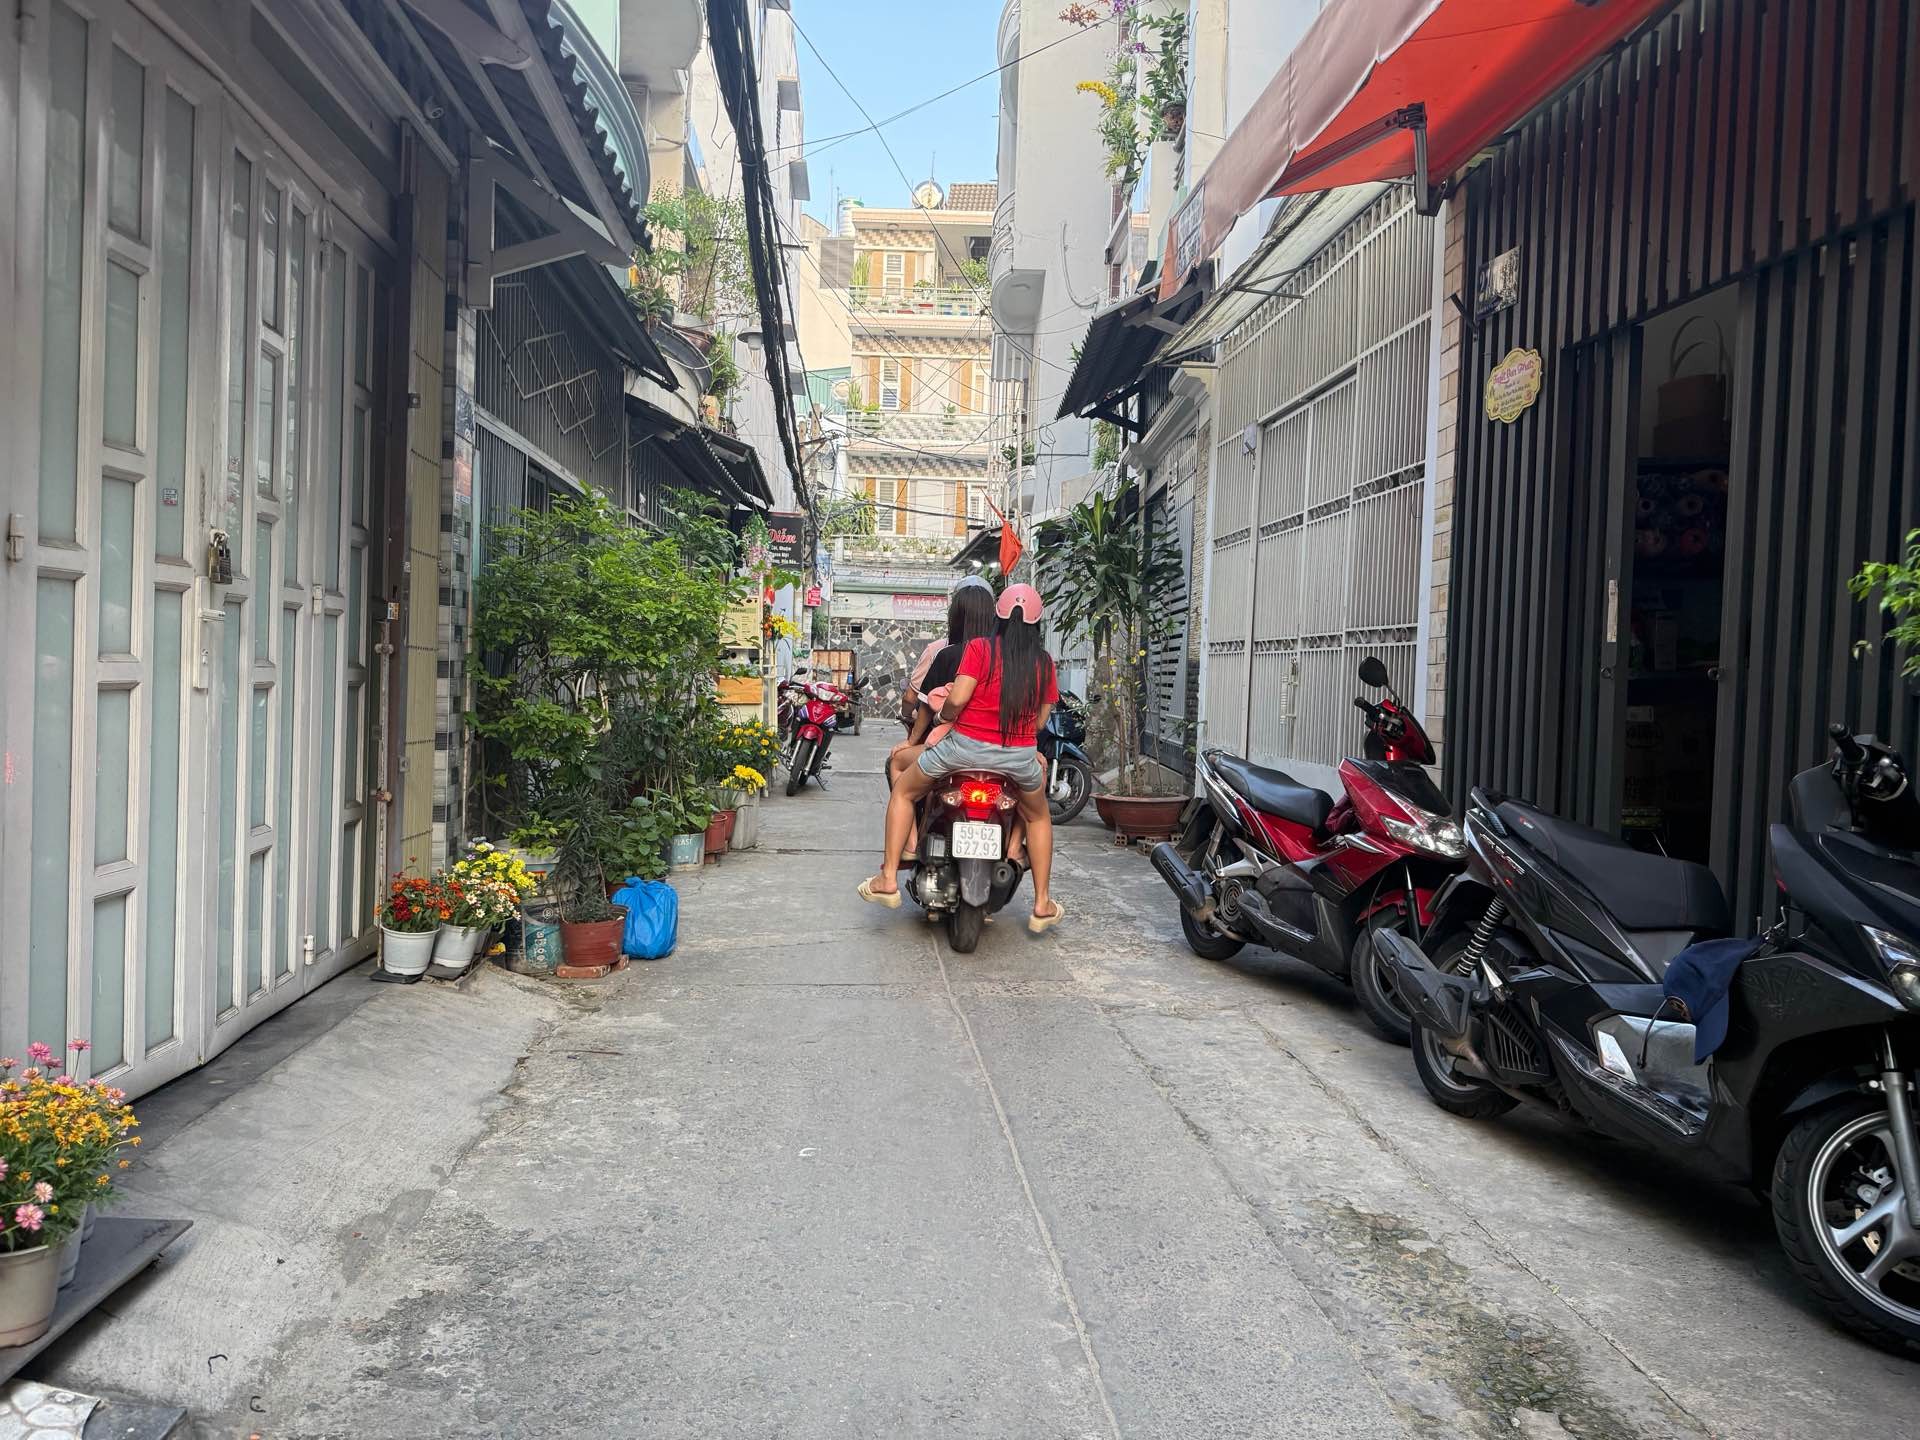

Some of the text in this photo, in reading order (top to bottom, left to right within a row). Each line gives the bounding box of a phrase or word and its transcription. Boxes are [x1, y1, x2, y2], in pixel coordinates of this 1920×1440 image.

[897, 598, 912, 608] TẠP
[914, 598, 931, 607] HÓA
[956, 840, 998, 857] 627.92
